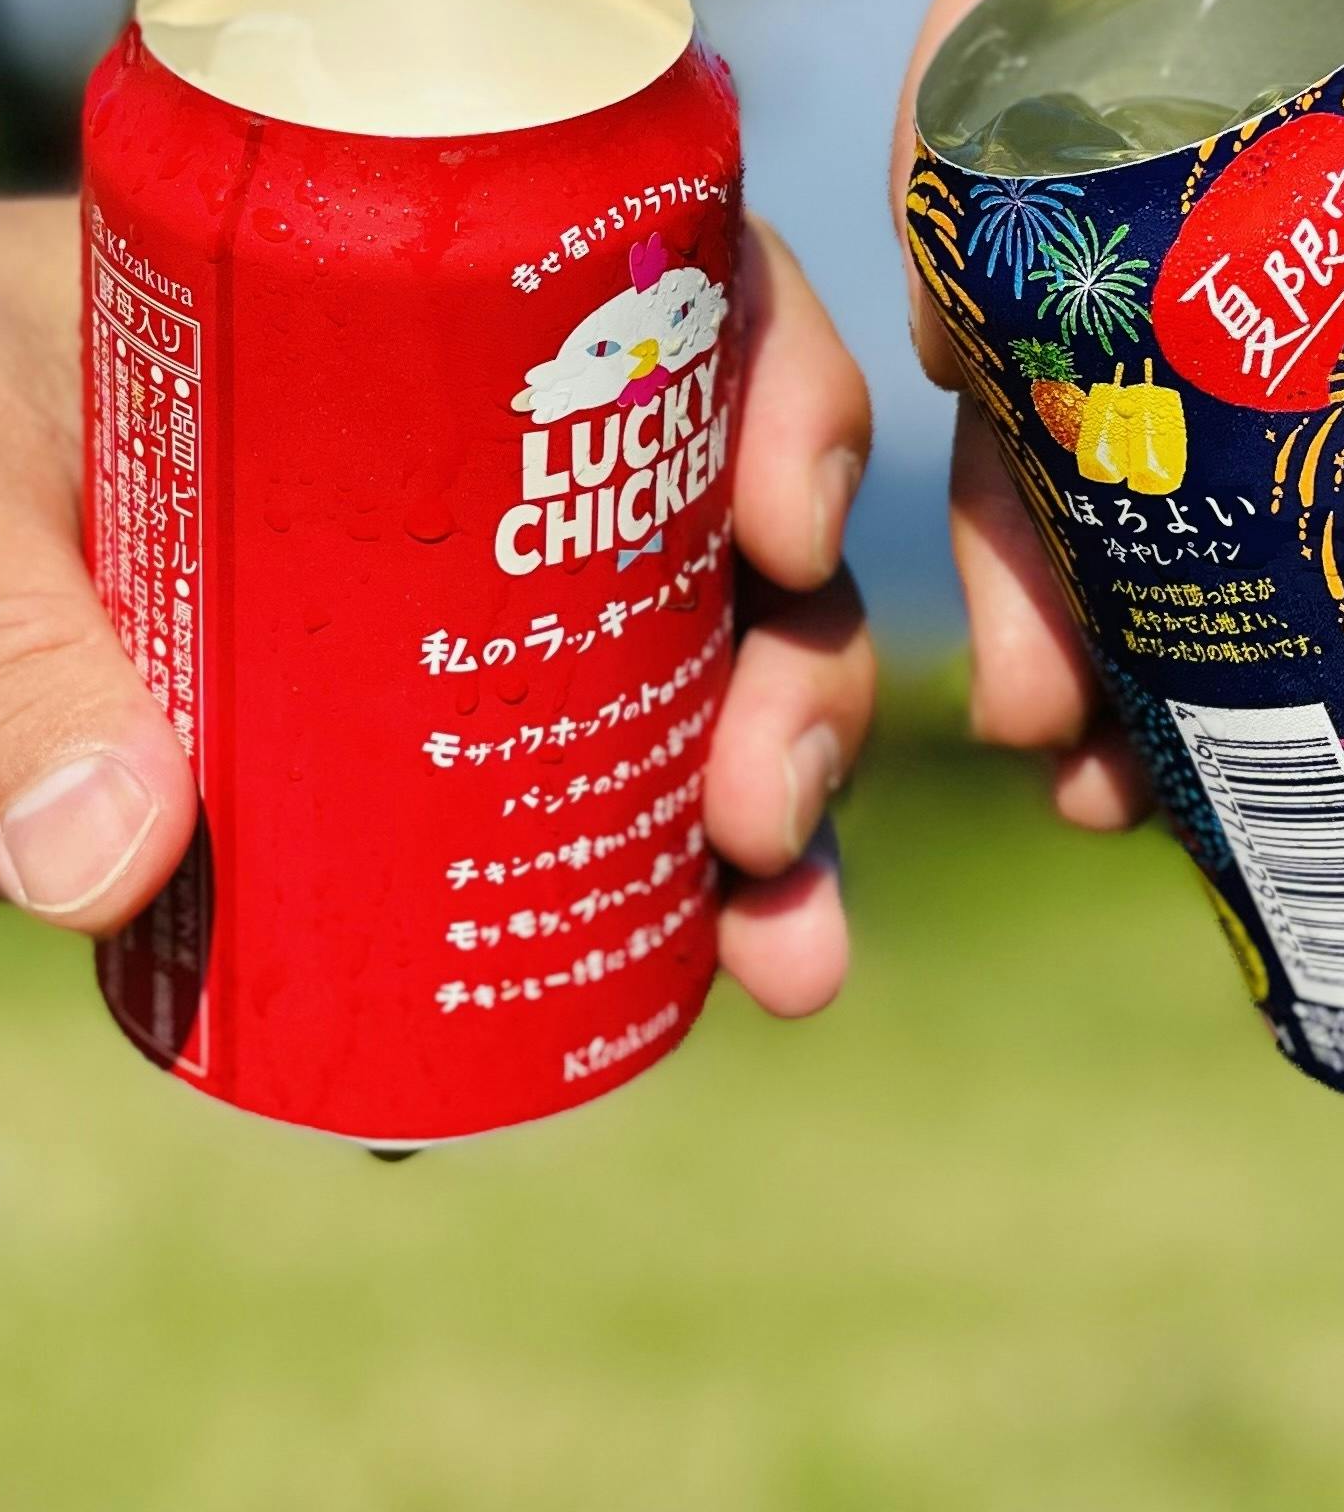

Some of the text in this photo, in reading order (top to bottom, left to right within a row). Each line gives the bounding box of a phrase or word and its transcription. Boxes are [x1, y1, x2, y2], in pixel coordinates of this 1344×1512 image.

[107, 228, 194, 308] Kizakura
[511, 175, 728, 294] 幸せ届けるクラフトビール
[99, 268, 181, 353] 酵母入り
[522, 346, 720, 502] LUCKY
[494, 403, 729, 576] CHICKEN
[1065, 491, 1256, 534] ほろよい
[1103, 537, 1241, 566] 冷やしパイン
